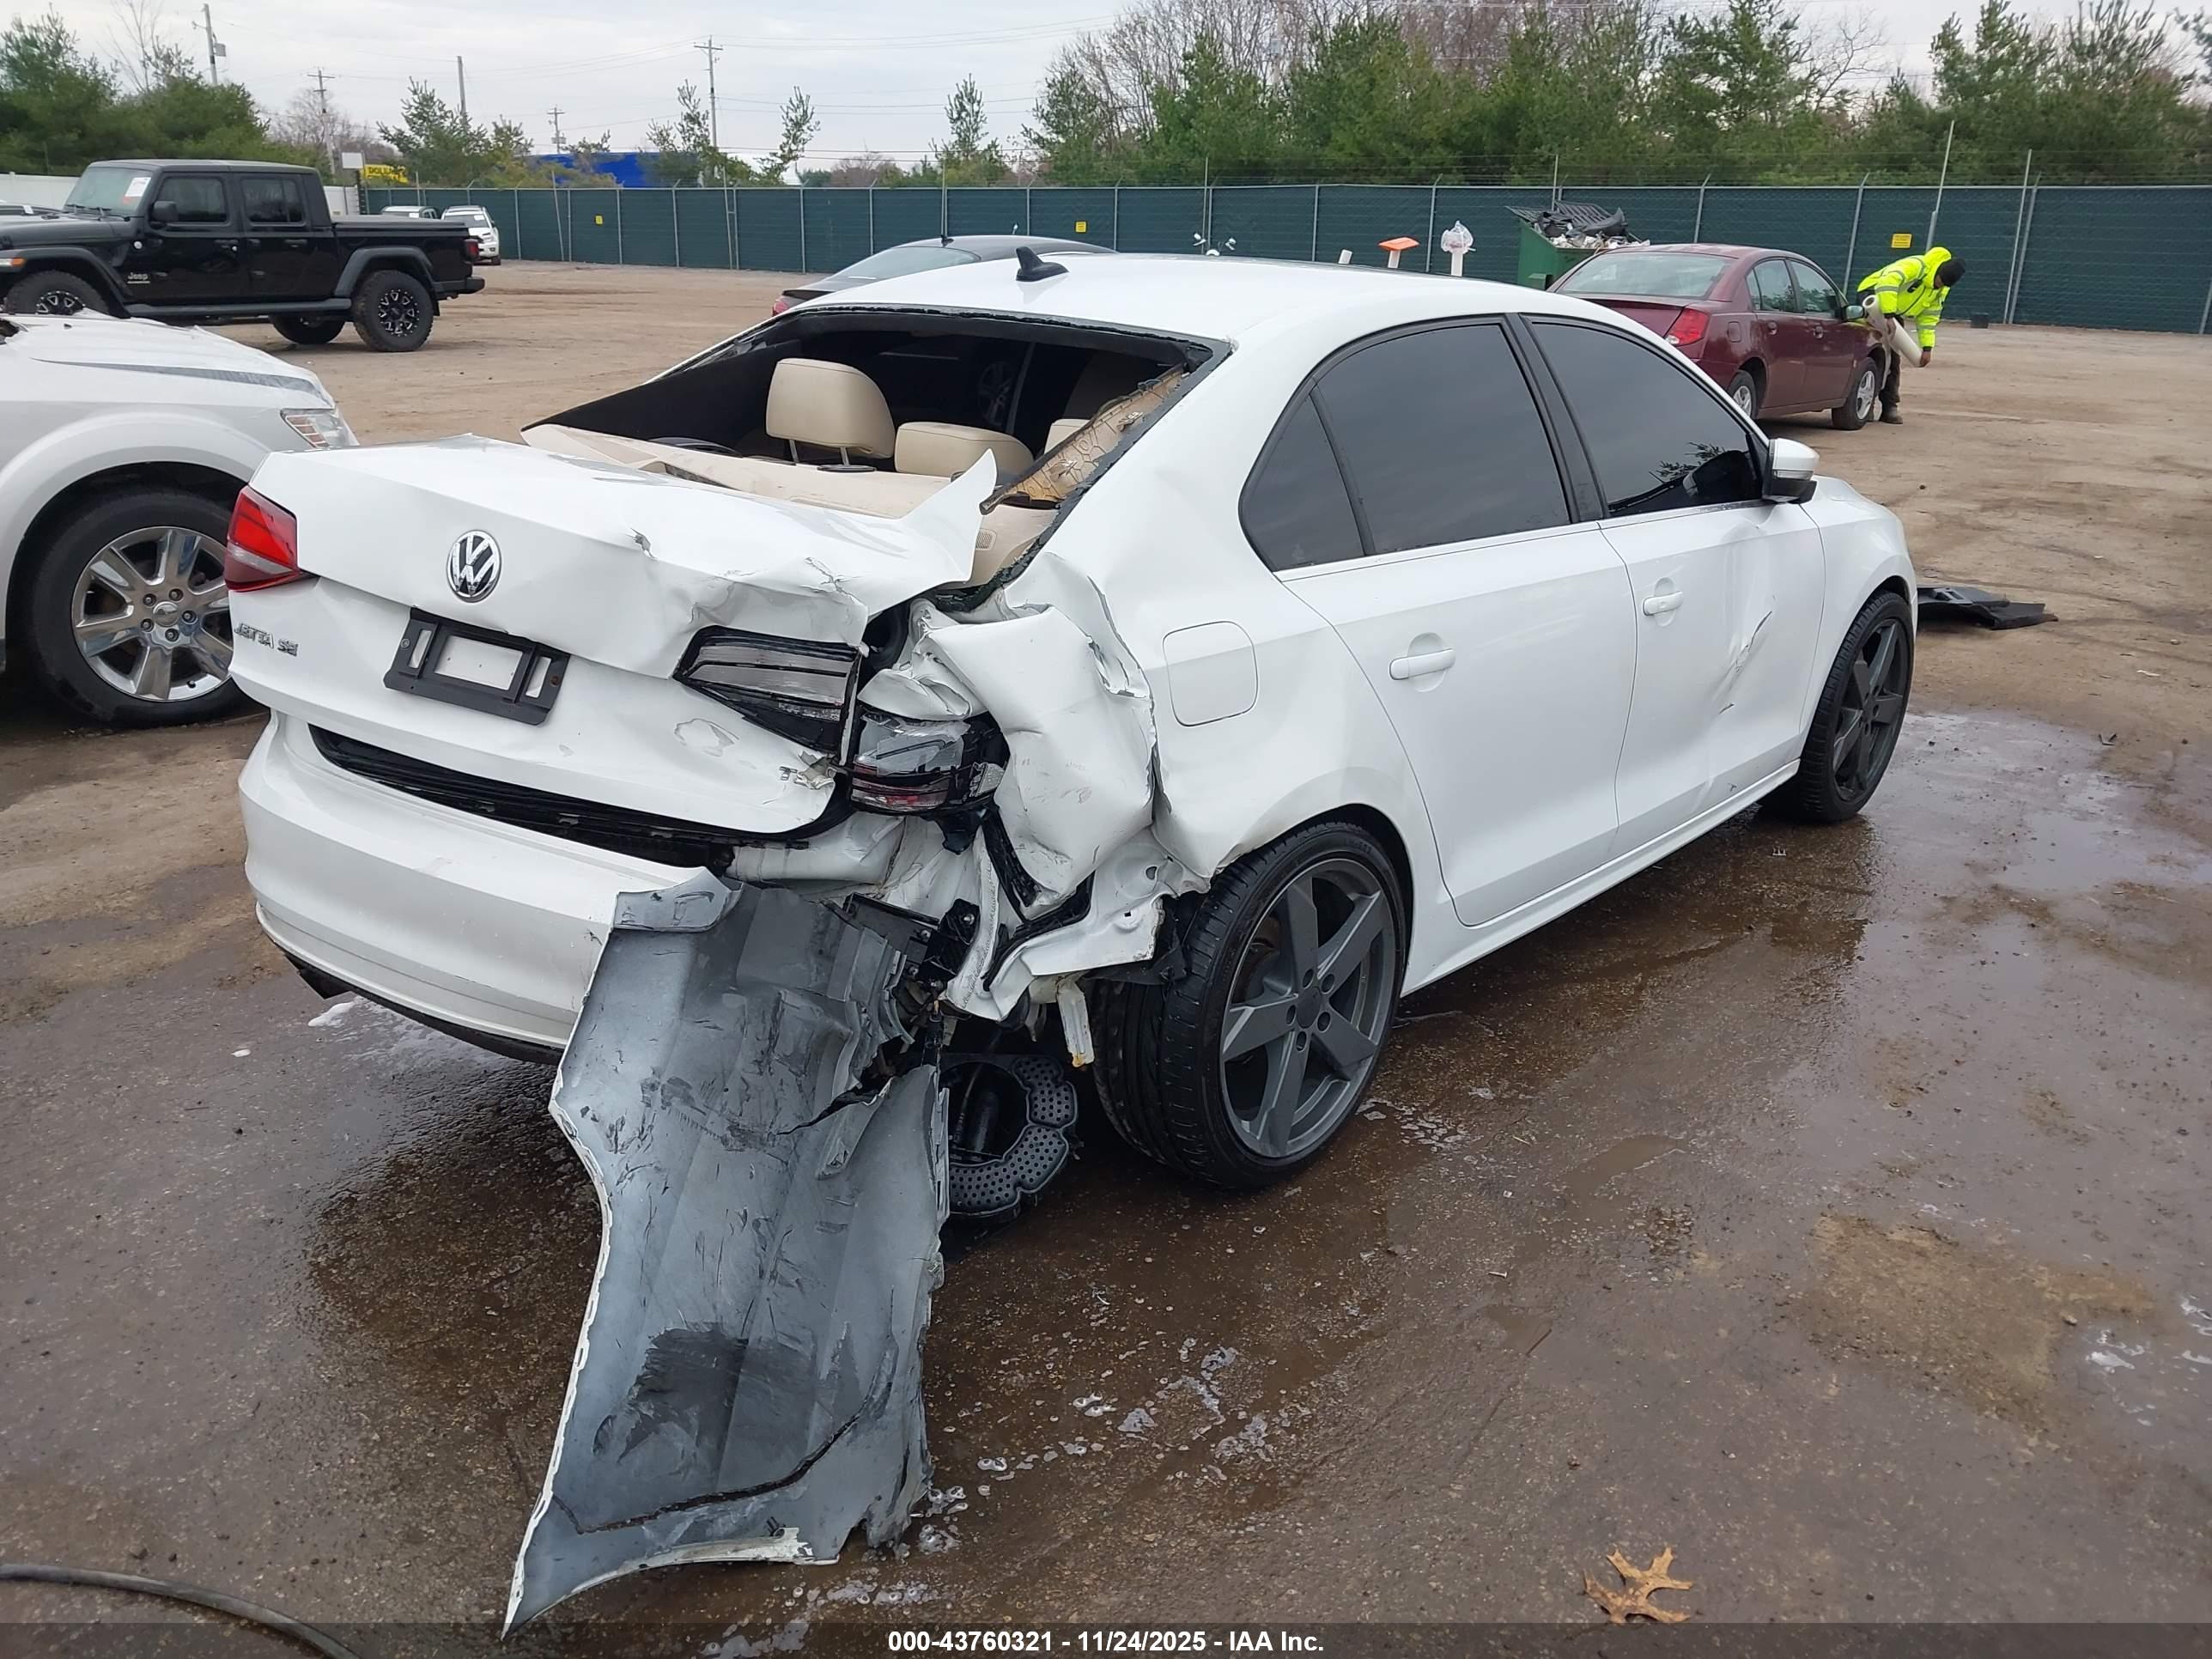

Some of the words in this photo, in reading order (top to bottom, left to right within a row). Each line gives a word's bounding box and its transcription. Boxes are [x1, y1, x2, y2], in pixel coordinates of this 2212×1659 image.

[128, 271, 149, 281] Jeep
[234, 623, 275, 650] JETTA
[277, 638, 299, 657] SE
